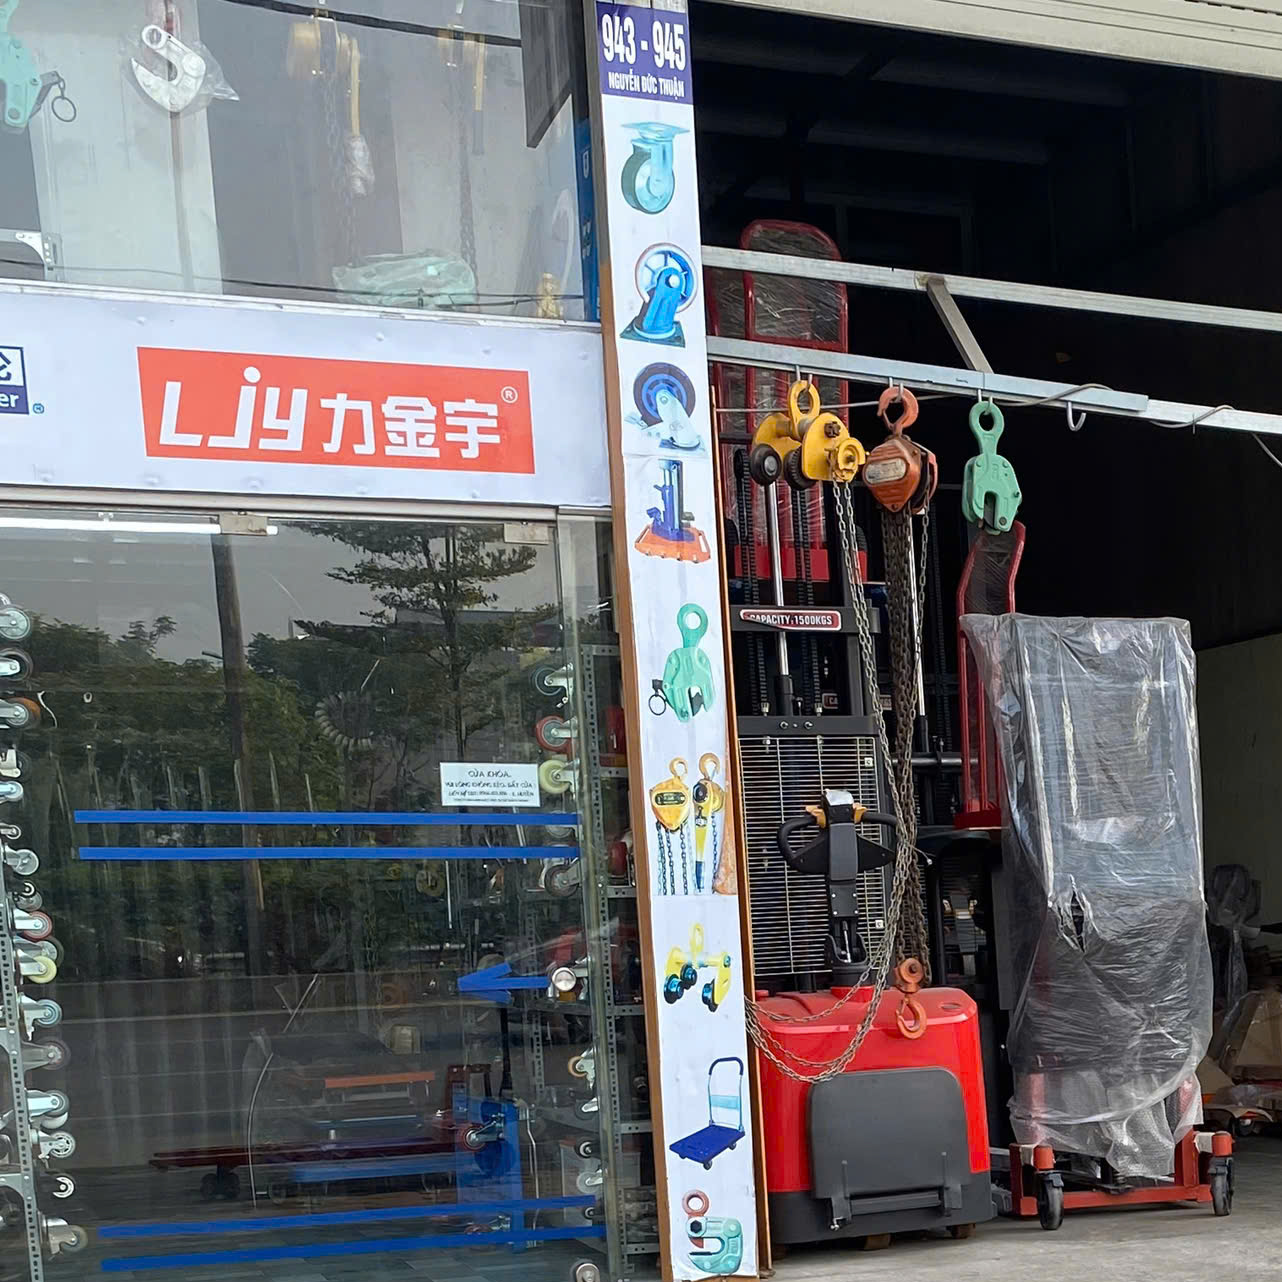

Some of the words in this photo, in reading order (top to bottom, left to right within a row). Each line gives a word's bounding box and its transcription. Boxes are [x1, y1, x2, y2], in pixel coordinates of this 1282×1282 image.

[602, 14, 636, 65] 943
[640, 40, 649, 51] -
[652, 21, 686, 71] 945
[641, 73, 658, 94] ĐỨC
[658, 76, 684, 100] THUẬN
[319, 392, 500, 459] 力金宇
